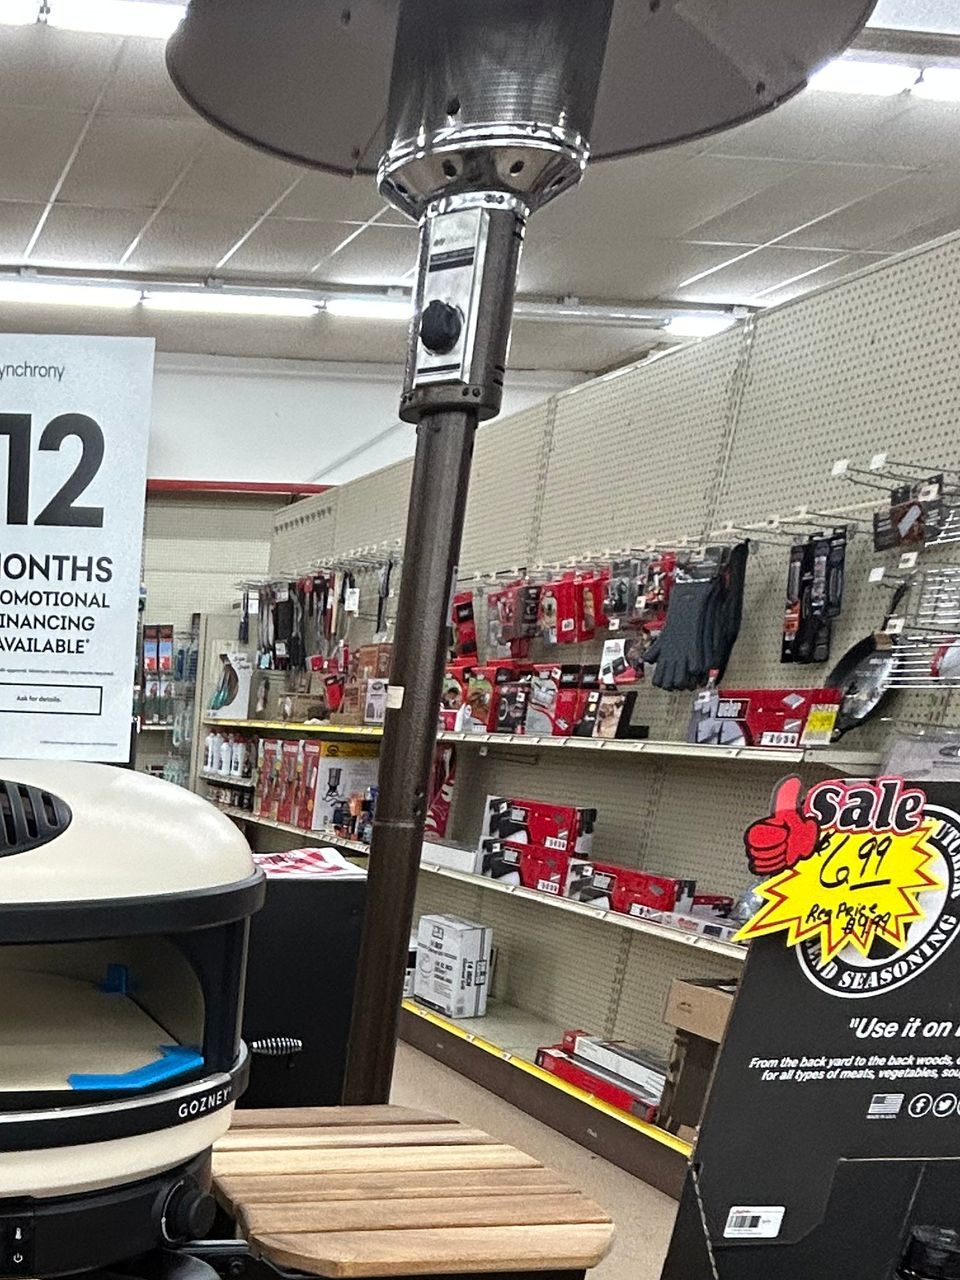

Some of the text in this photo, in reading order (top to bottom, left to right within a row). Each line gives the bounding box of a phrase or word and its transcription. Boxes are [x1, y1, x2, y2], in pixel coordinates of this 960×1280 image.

[836, 902, 878, 919] Price
[837, 914, 958, 990] SEASONING
[848, 1017, 953, 1039] "Use it on
[748, 1055, 954, 1069] From the back yard to the back woods,
[761, 1070, 778, 1081] for
[779, 1069, 794, 1080] all
[794, 1069, 825, 1082] types
[826, 1068, 841, 1080] of
[840, 1068, 876, 1080] meats,
[878, 1068, 939, 1081] vegetables,
[178, 1087, 229, 1118] GOZNEY
